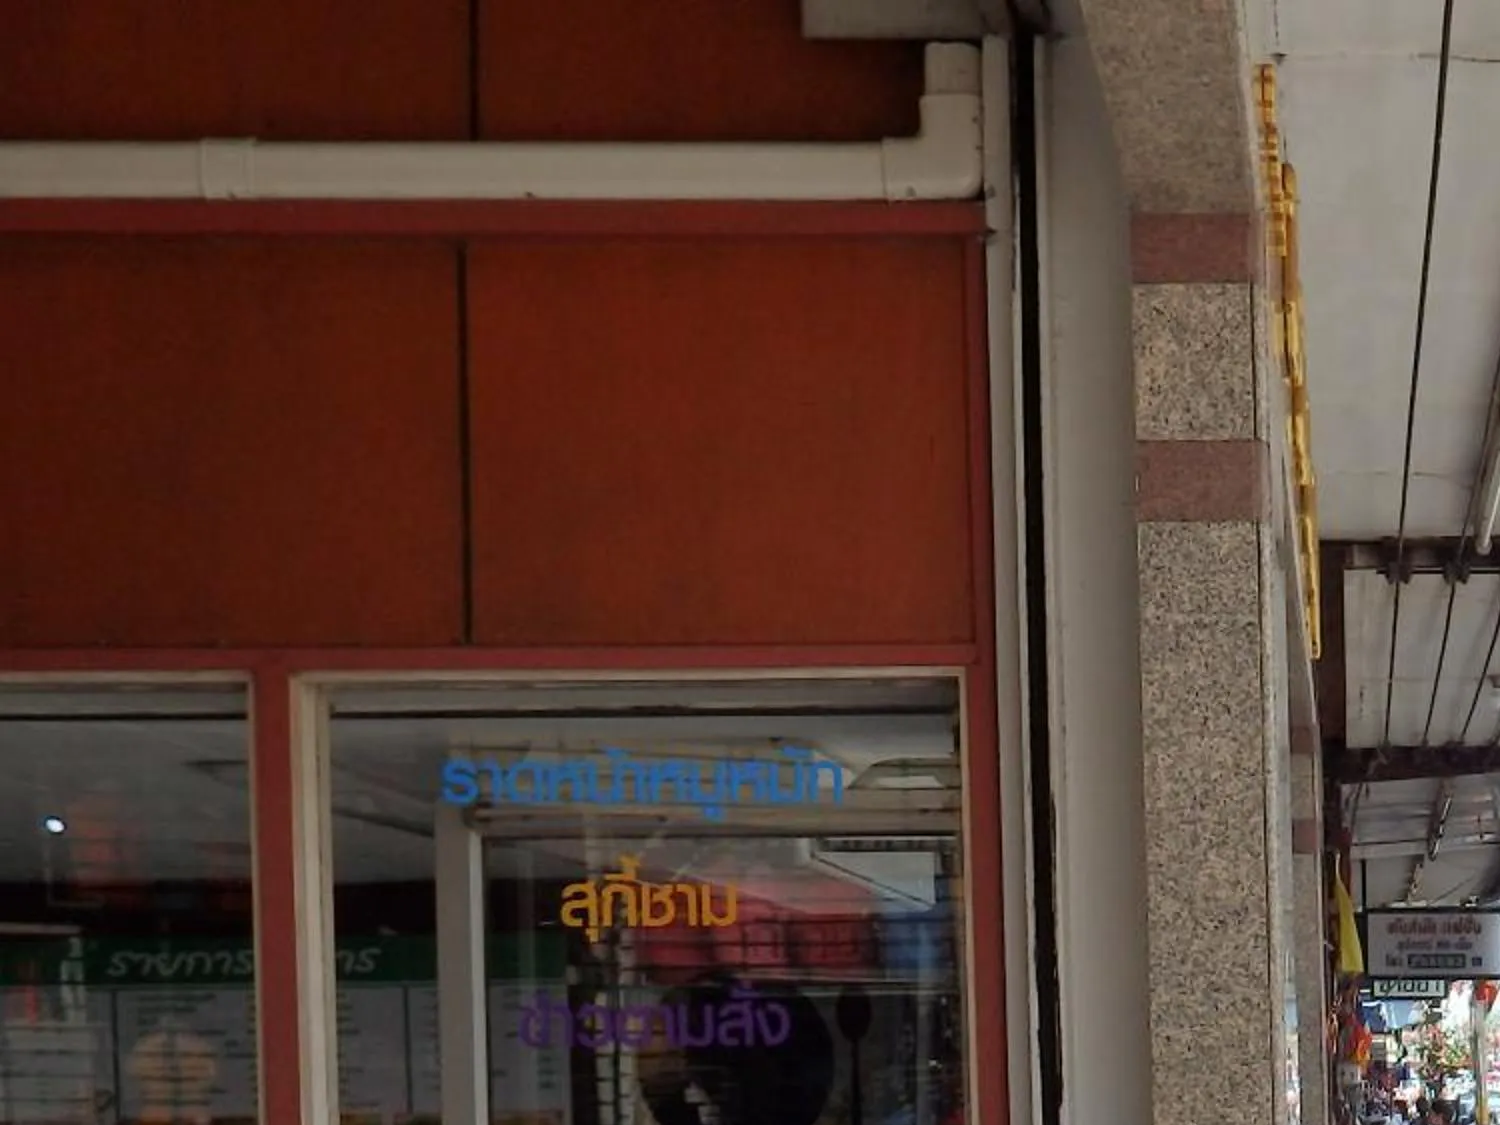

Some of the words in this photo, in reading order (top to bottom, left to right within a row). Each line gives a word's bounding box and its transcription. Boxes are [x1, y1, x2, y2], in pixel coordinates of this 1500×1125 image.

[440, 747, 842, 821] ราดหน้าหมูหมัก
[560, 856, 739, 942] สุกี้ชาม
[517, 981, 791, 1049] ข้าวตามสั่ง
